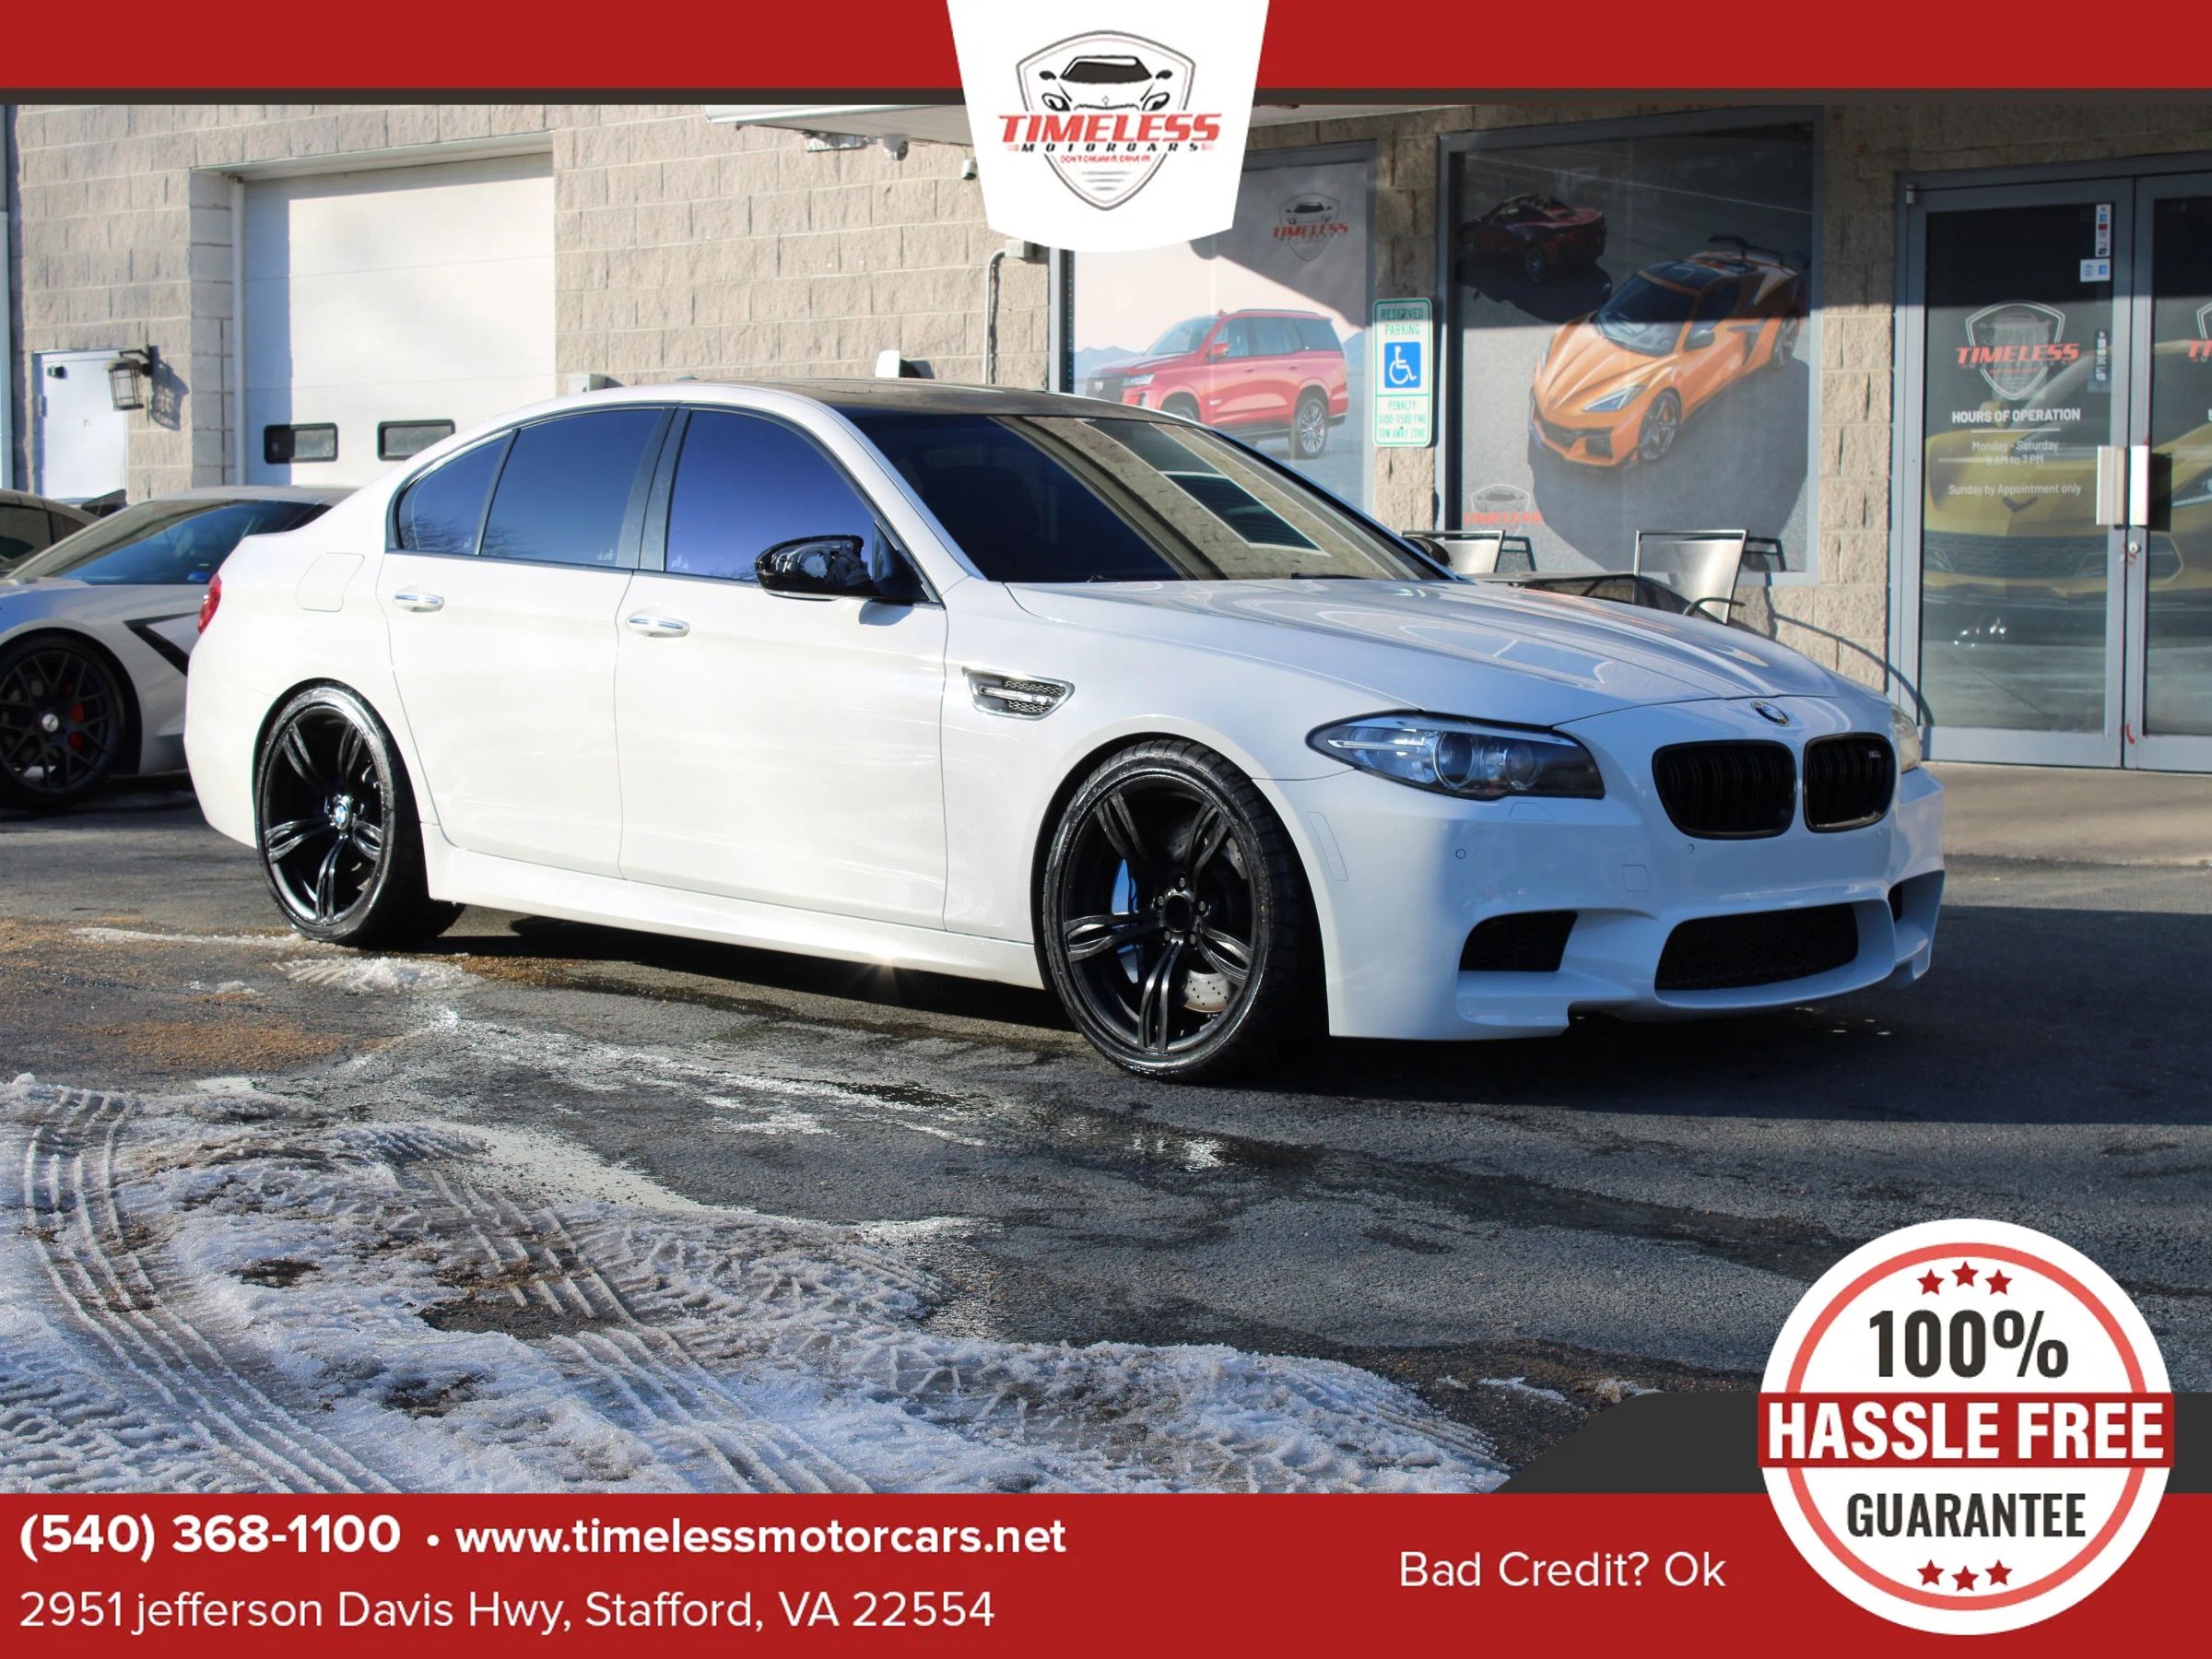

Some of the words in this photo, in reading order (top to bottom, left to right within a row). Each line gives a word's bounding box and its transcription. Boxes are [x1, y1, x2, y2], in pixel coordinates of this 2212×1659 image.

[1381, 308, 1424, 321] RESERVED
[1385, 324, 1420, 335] PARKING
[1956, 343, 2079, 364] TIMELESS
[1952, 410, 1992, 424] HOURS
[1994, 409, 2010, 422] OF
[2012, 407, 2081, 422] OPERATION
[1972, 441, 2008, 453] Monday
[2016, 441, 2059, 453] Saturday
[1994, 455, 2008, 465] AM
[2010, 455, 2020, 465] to
[2030, 454, 2044, 465] PM
[1948, 484, 1982, 497] Sunday
[1984, 485, 1995, 496] by
[1998, 484, 2059, 496] Appointment
[2062, 483, 2082, 495] only
